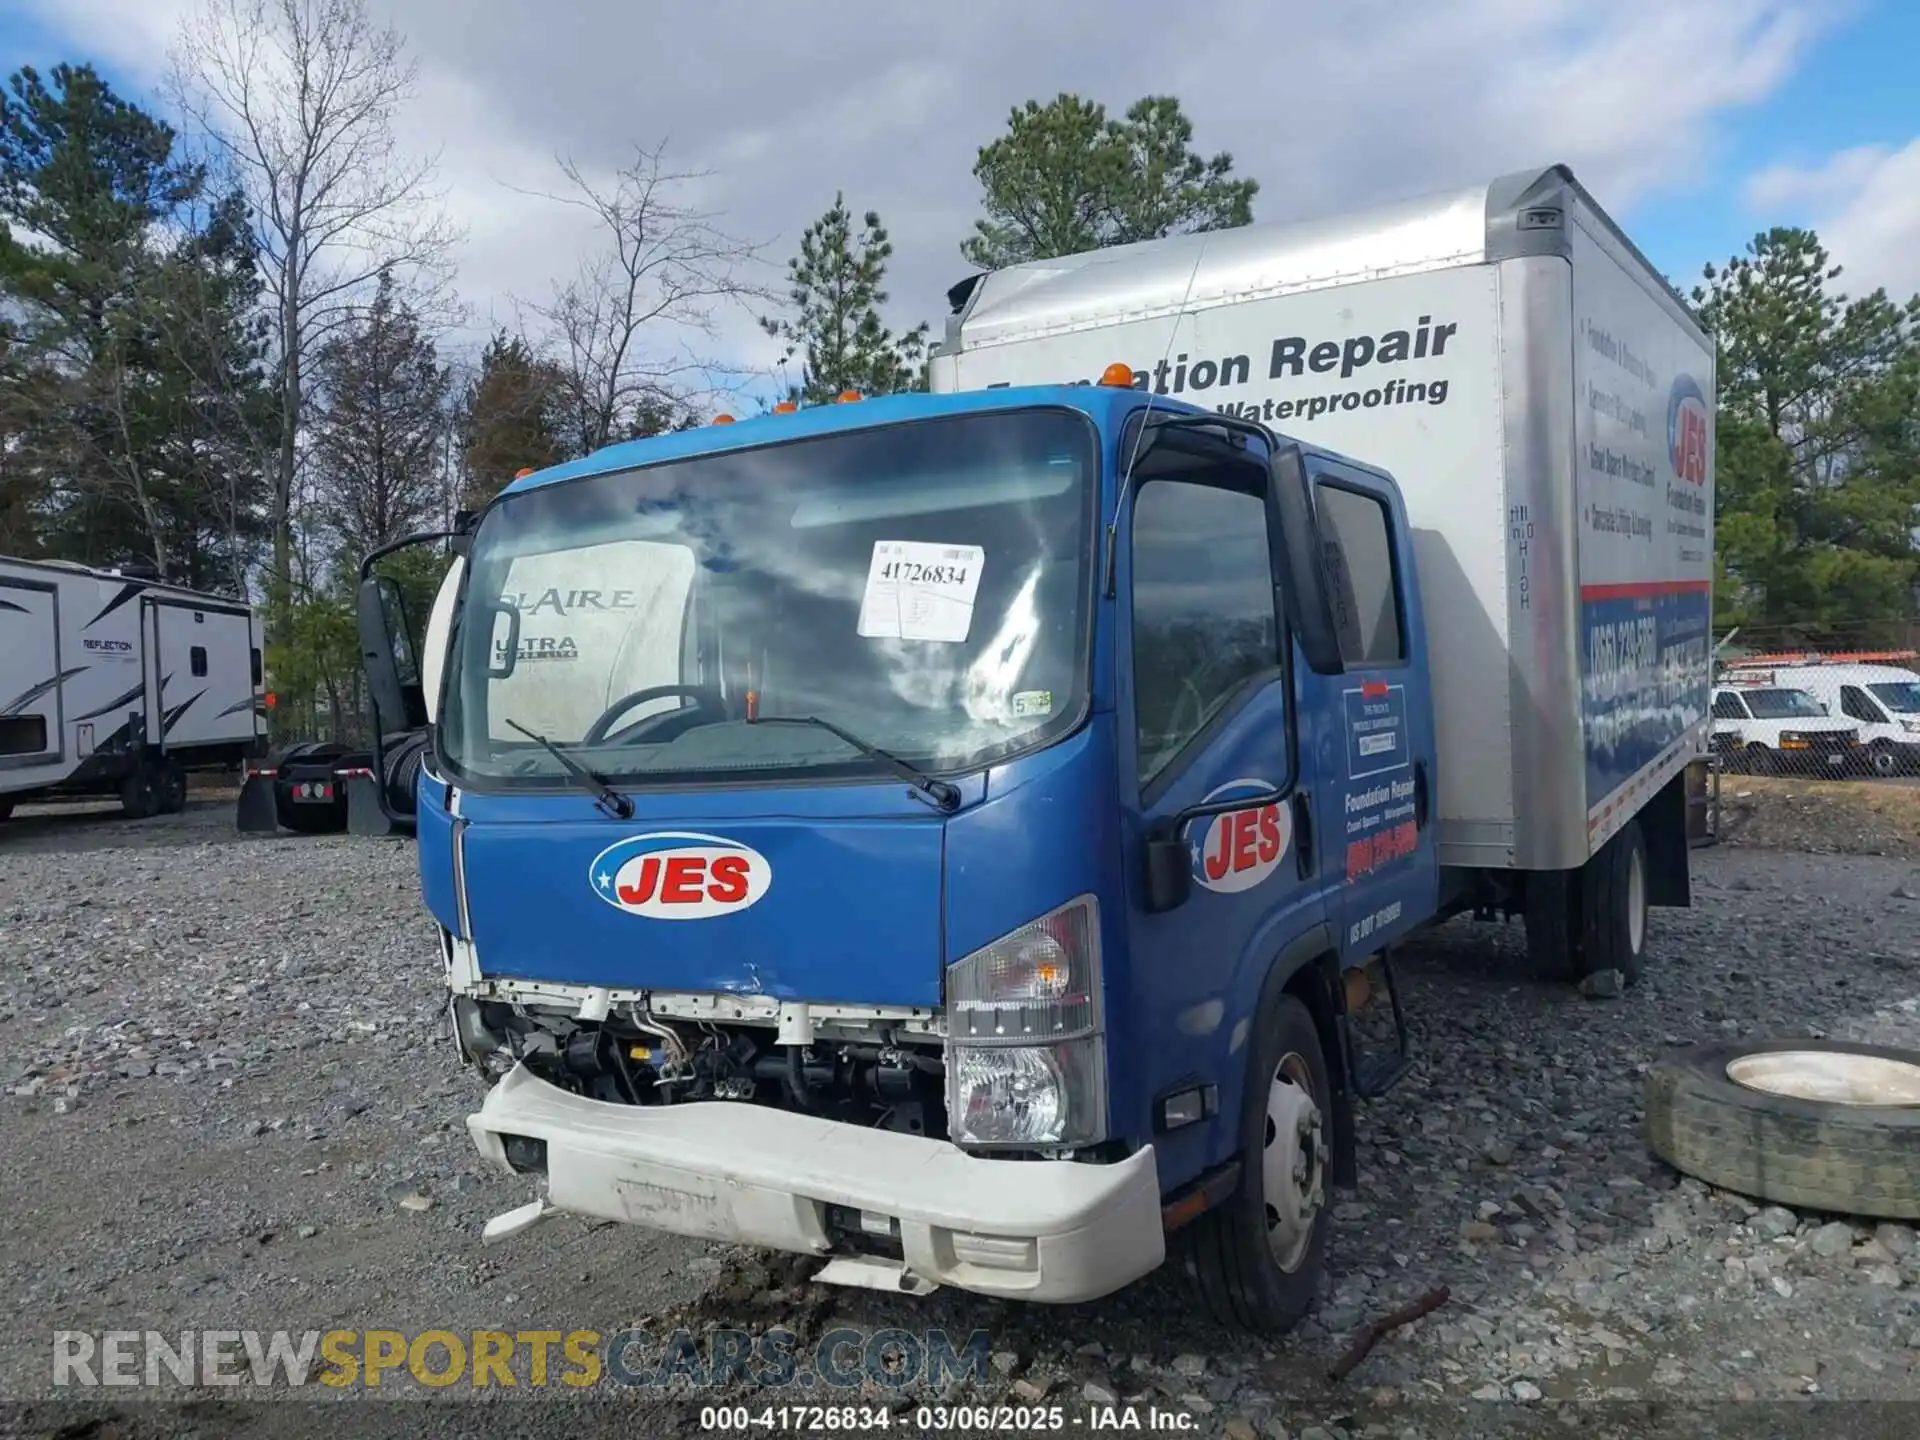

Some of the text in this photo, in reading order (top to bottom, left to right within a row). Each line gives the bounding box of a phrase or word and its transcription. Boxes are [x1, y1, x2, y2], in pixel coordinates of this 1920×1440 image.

[1269, 315, 1457, 379] Repair
[1217, 379, 1449, 421] Waterproofing
[1675, 403, 1706, 487] JES
[881, 561, 967, 585] 41726834
[83, 639, 133, 651] REFLECTION
[1345, 785, 1390, 815] Foundation
[1391, 776, 1416, 801] Repair
[1206, 801, 1280, 880] JES
[618, 856, 751, 905] JES
